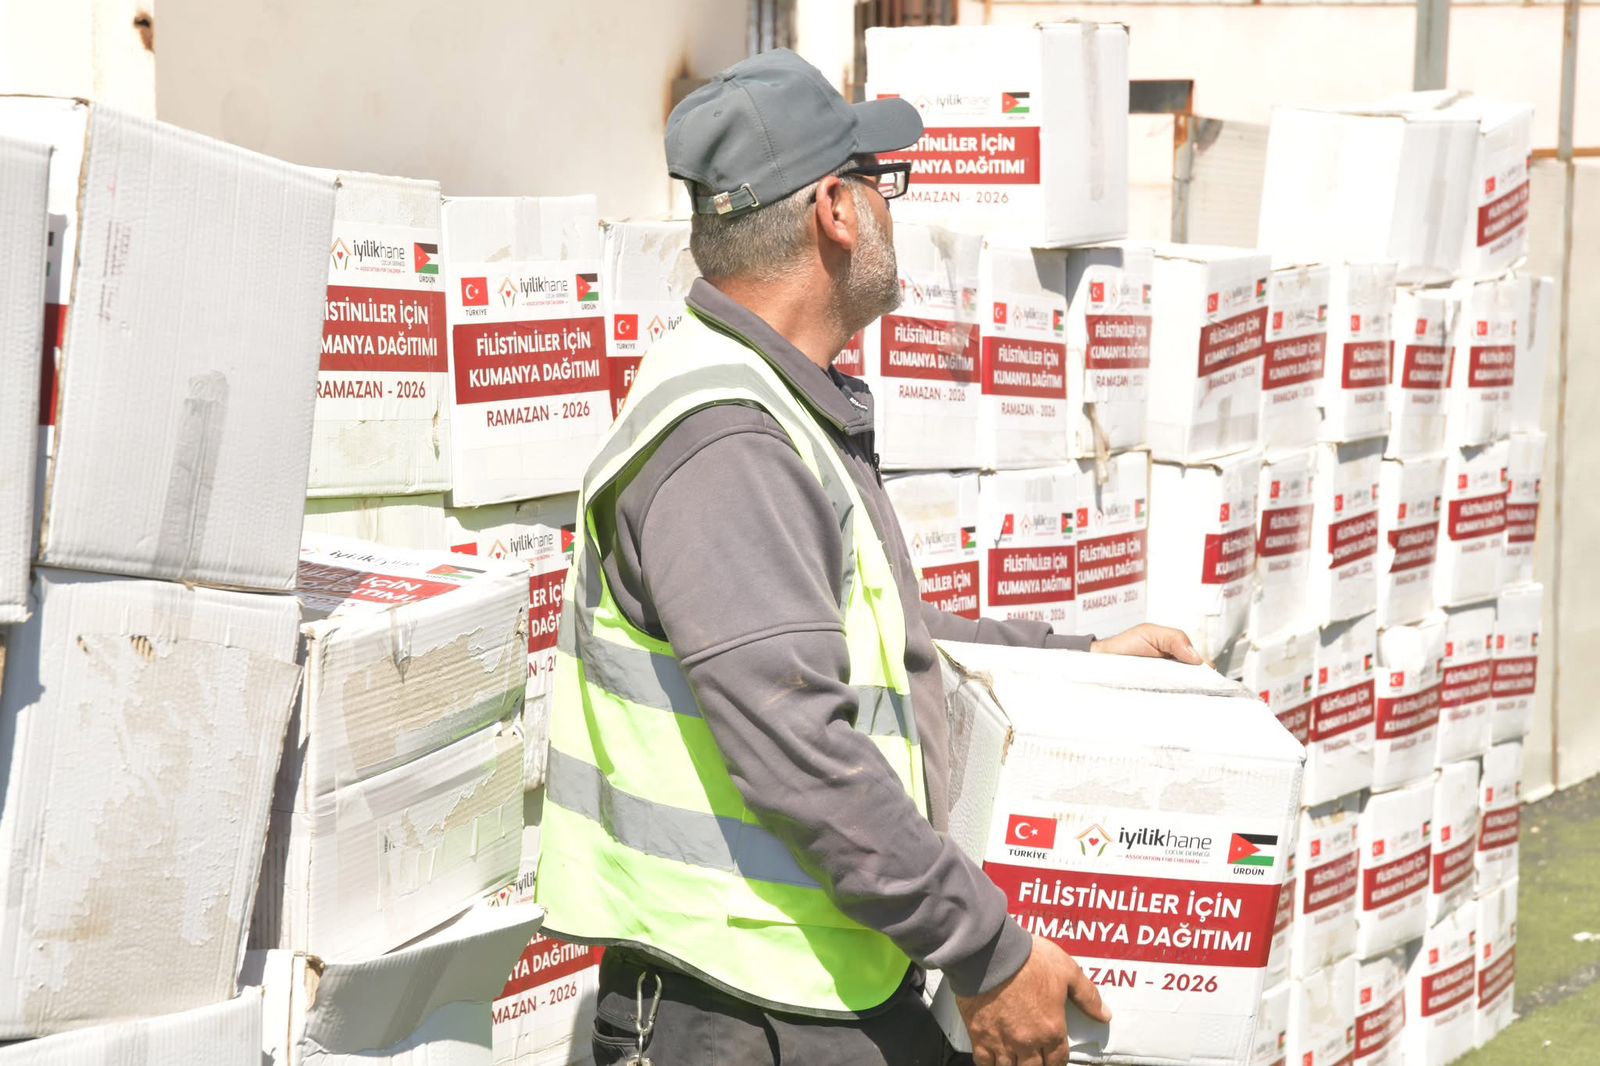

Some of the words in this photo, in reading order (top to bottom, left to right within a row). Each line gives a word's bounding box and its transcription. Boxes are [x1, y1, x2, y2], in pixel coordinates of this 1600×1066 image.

[981, 133, 1015, 156] İÇİN
[955, 156, 1026, 174] DAĞITIMI
[976, 191, 1009, 204] 2026
[354, 240, 405, 262] iyilikhane
[520, 276, 568, 298] iyilikhane
[325, 297, 396, 324] İSTİNLİLER
[400, 300, 429, 330] İÇİN
[465, 309, 487, 317] TÜRKİYE
[320, 335, 374, 355] MANYA
[378, 331, 437, 356] DAĞITIMI
[477, 329, 561, 357] FİLİSTİNLİLER
[563, 327, 592, 355] İÇİN
[889, 350, 937, 368] KUMANYA
[998, 343, 1042, 366] FİLİSTİNLİLER
[1043, 348, 1059, 370] İÇİN
[469, 364, 541, 388] KUMANYA
[543, 357, 600, 382] DAĞITIMI
[993, 369, 1031, 386] KUMANYA
[1032, 371, 1063, 389] DAĞITIMI
[397, 380, 426, 399] 2026
[899, 385, 941, 401] RAMAZAN
[949, 388, 966, 402] 2026
[487, 405, 549, 428] RAMAZAN
[562, 401, 590, 419] 2026
[1001, 402, 1035, 416] RAMAZAN
[510, 534, 554, 557] iyilikhane
[1080, 541, 1126, 563] FİLİSTİNLİLER
[1127, 537, 1141, 557] İÇİN
[1004, 553, 1051, 573] FİLİSTİNLİLER
[1052, 551, 1067, 573] İÇİN
[953, 569, 972, 592] İÇİN
[998, 580, 1041, 596] KUMANYA
[1041, 575, 1072, 592] DAĞITIMI
[1077, 567, 1114, 585] KUMANYA
[549, 578, 565, 608] İÇİ
[941, 594, 977, 612] DAĞITIMI
[1083, 595, 1117, 611] RAMAZAN
[1119, 827, 1212, 850] iyilikhane
[1009, 848, 1048, 860] TÜRKİYE
[1232, 866, 1265, 876] ÜRDÜN
[1018, 877, 1180, 915] FİLİSTİNLİLER
[1186, 889, 1242, 922] İÇİN
[1010, 914, 1129, 944] UMANYA
[1136, 923, 1252, 952] DAĞITIMI
[533, 943, 589, 973] DAĞITIMI
[1162, 973, 1218, 993] 2026
[492, 996, 537, 1025] MAZAN
[550, 981, 577, 1006] 2026
